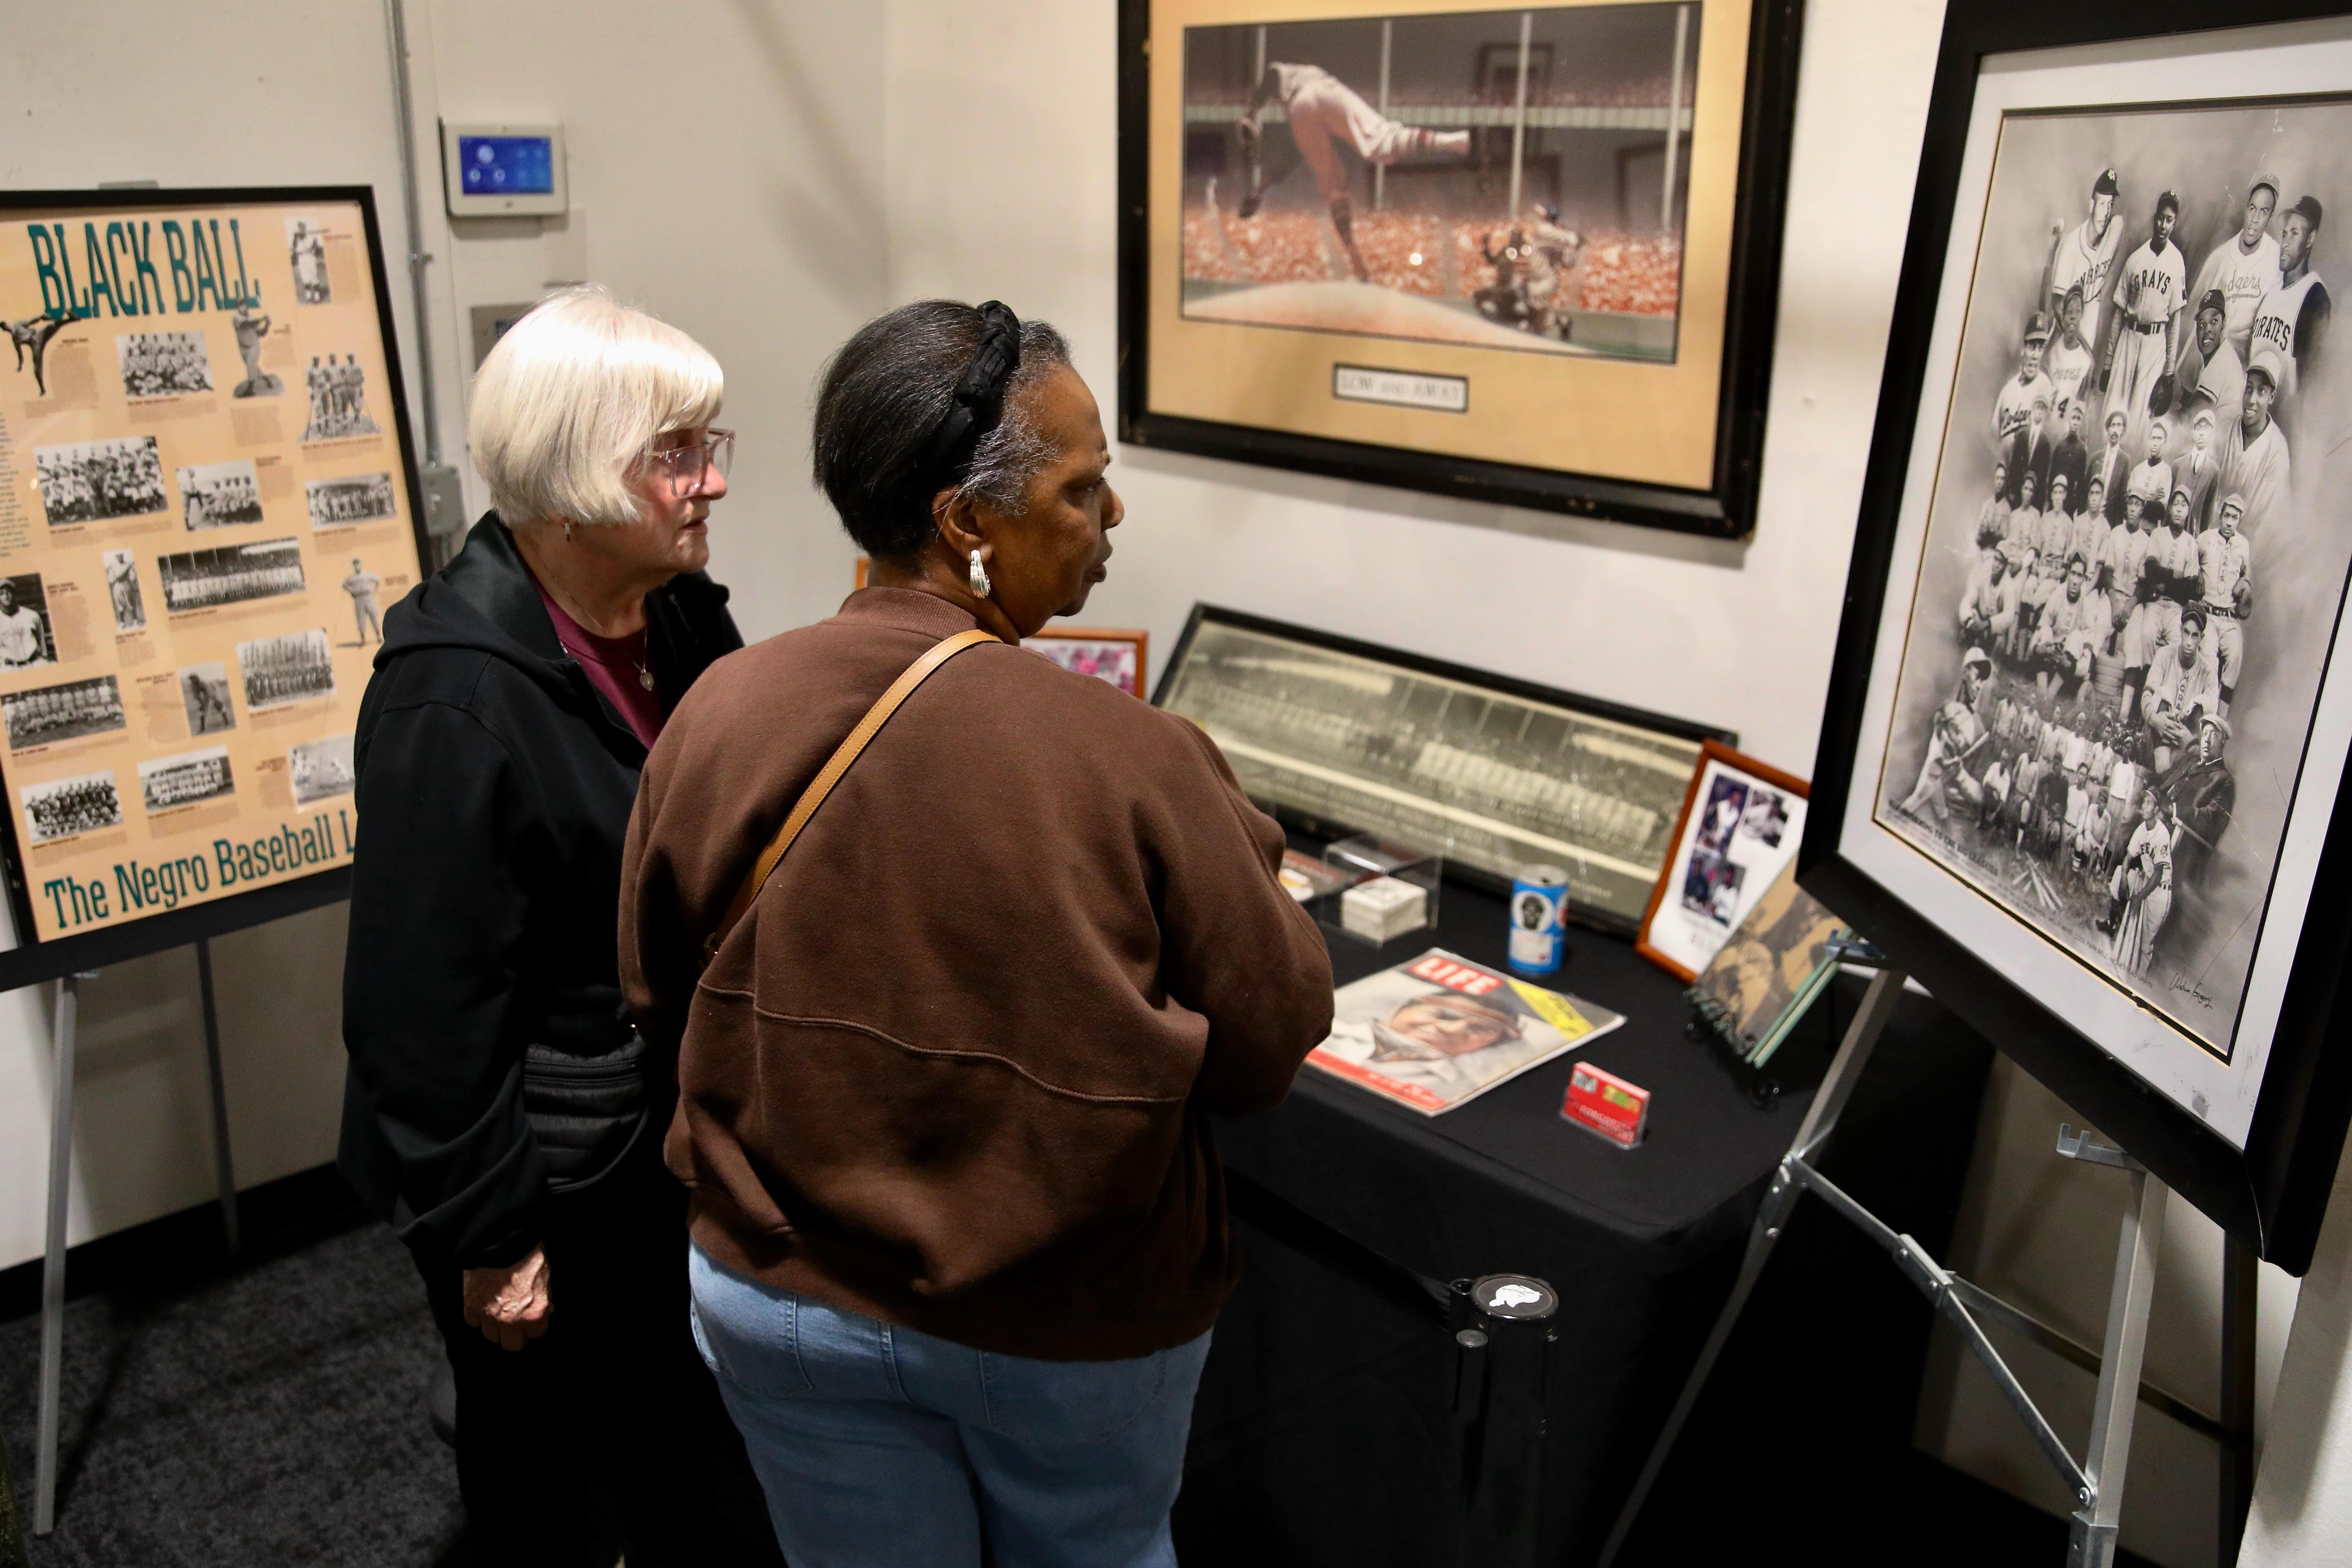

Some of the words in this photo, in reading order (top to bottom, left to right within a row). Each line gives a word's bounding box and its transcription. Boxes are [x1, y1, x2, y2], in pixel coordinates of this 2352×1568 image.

[27, 221, 165, 320] BLACK
[162, 218, 261, 313] BALL
[2133, 269, 2171, 295] GRAYS
[44, 875, 108, 929] The
[113, 861, 210, 909] Negro
[213, 814, 336, 887] Baseball
[1413, 958, 1498, 995] LIFE
